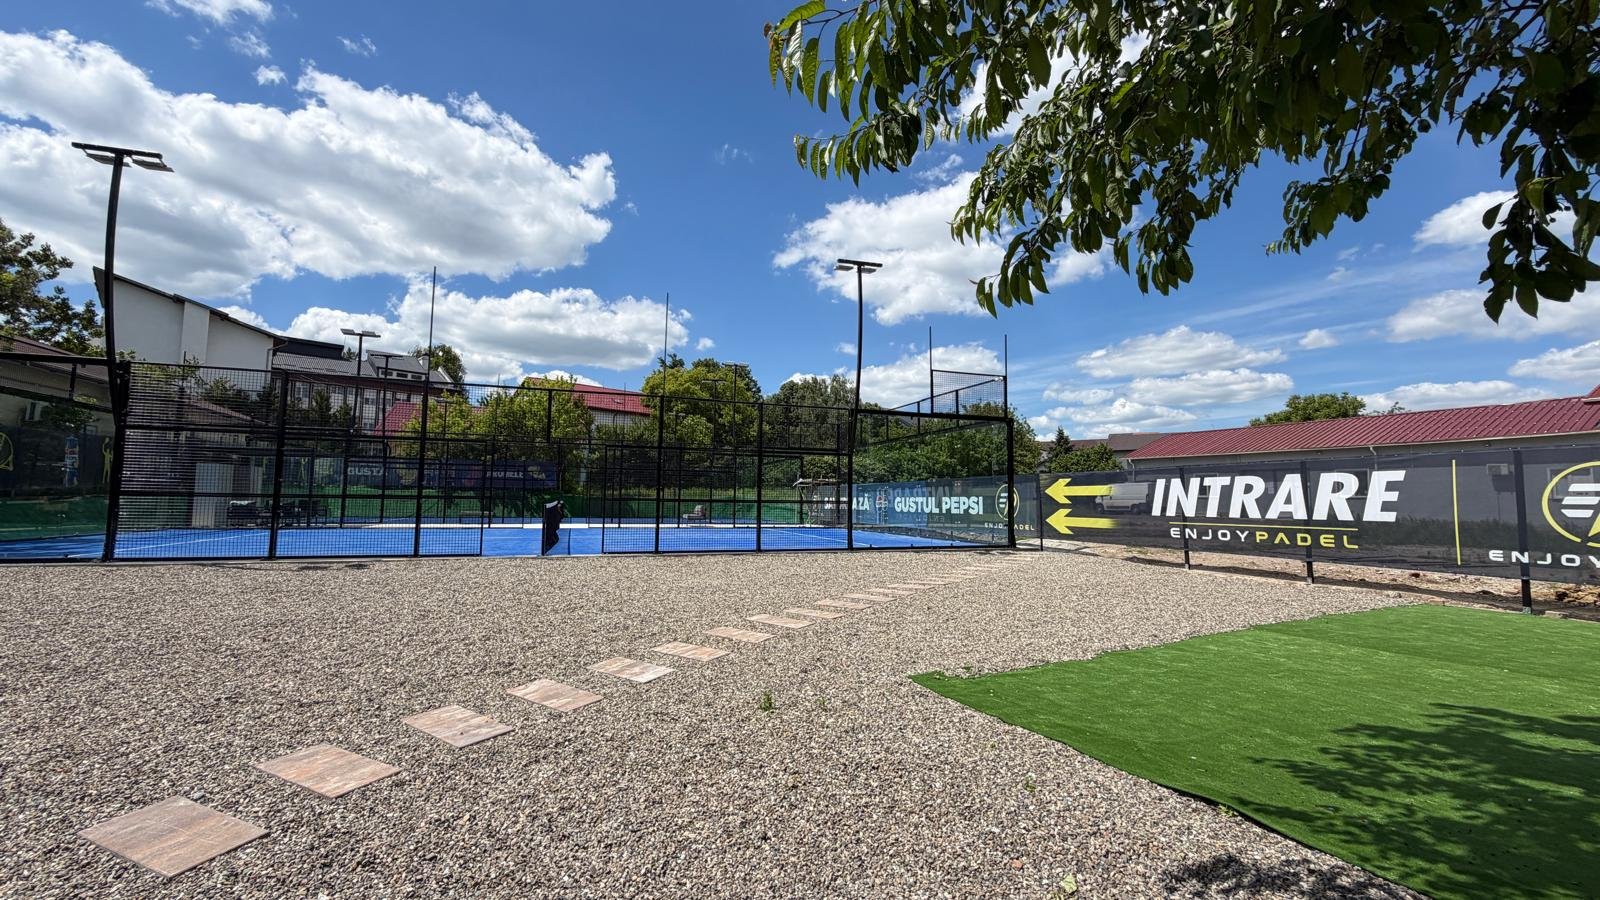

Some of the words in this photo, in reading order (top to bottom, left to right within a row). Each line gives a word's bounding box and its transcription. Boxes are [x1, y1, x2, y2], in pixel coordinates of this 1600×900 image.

[1151, 469, 1406, 522] INTRARE
[894, 496, 940, 514] GUSTUL
[942, 496, 984, 515] PEPSI
[984, 522, 1035, 531] ENJOADEL
